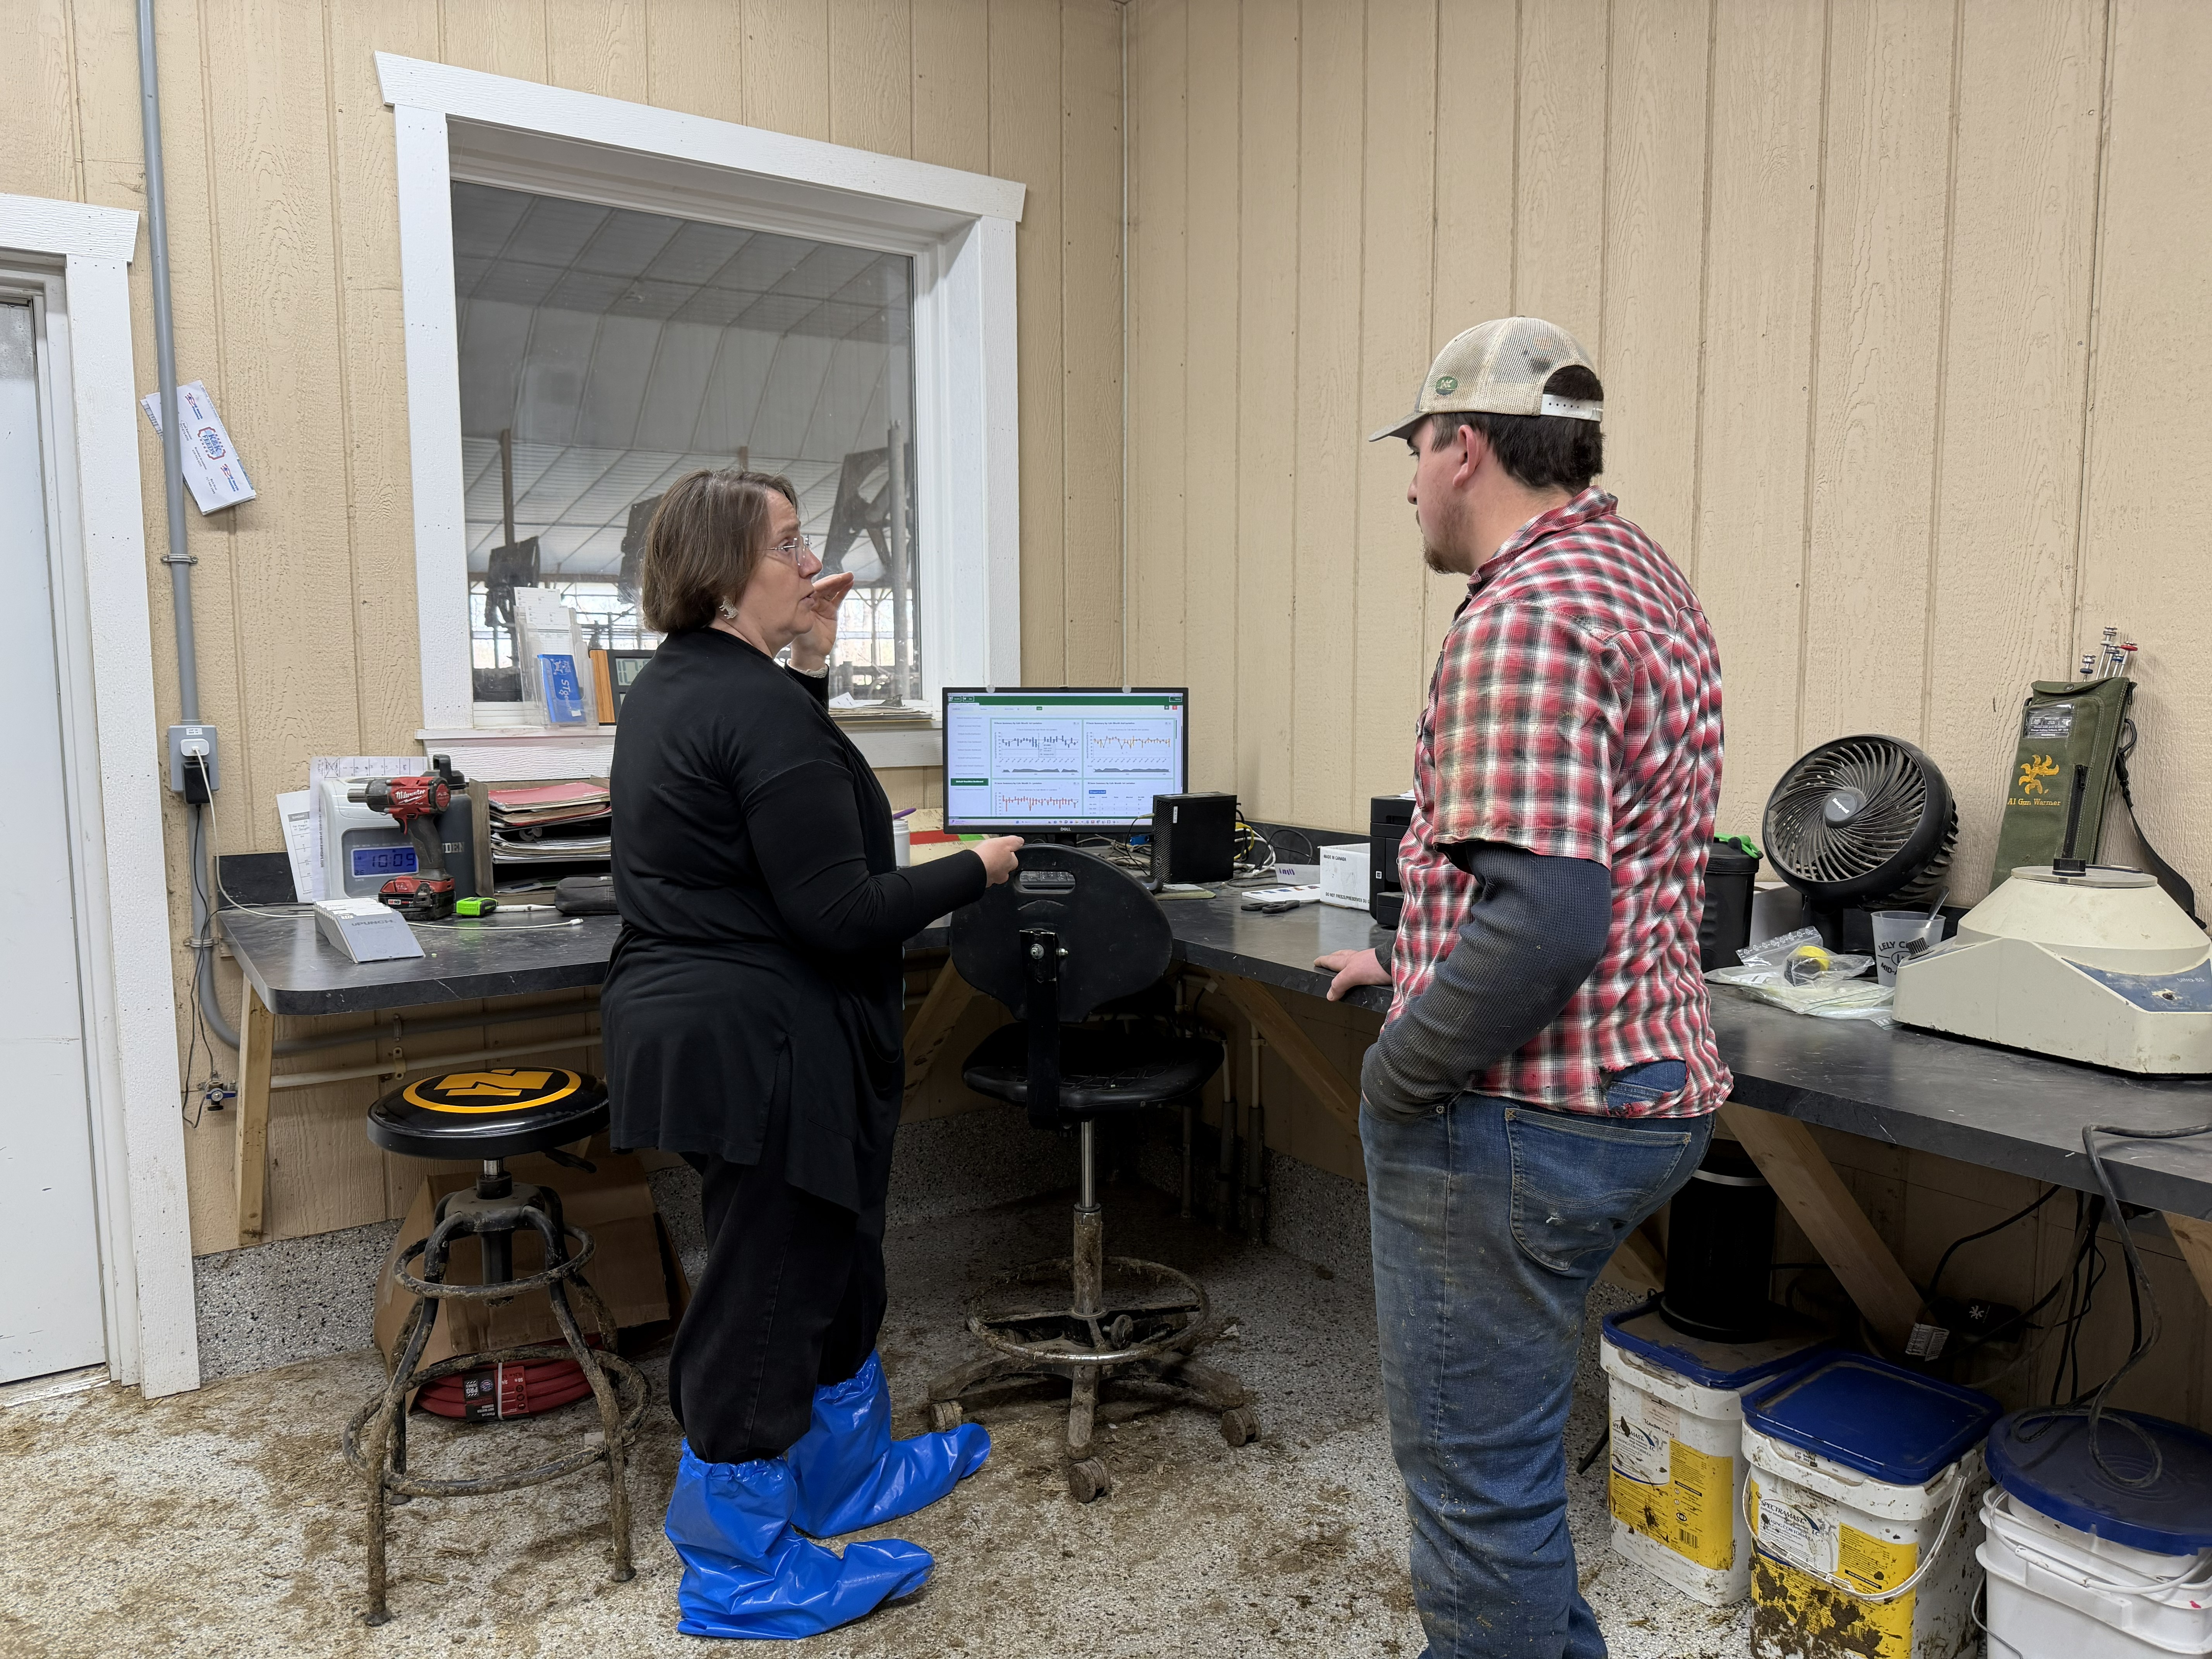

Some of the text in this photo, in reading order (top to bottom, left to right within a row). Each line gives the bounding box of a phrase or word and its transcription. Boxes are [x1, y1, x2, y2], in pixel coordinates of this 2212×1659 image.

[202, 434, 216, 455] FEEDS
[208, 434, 222, 452] K&K
[395, 789, 425, 800] Milwaukee
[372, 853, 416, 867] 10:09
[1879, 941, 1895, 951] LELY
[1613, 1421, 1644, 1442] SPECMAST
[1761, 1500, 1804, 1524] SPECTRAMAST
